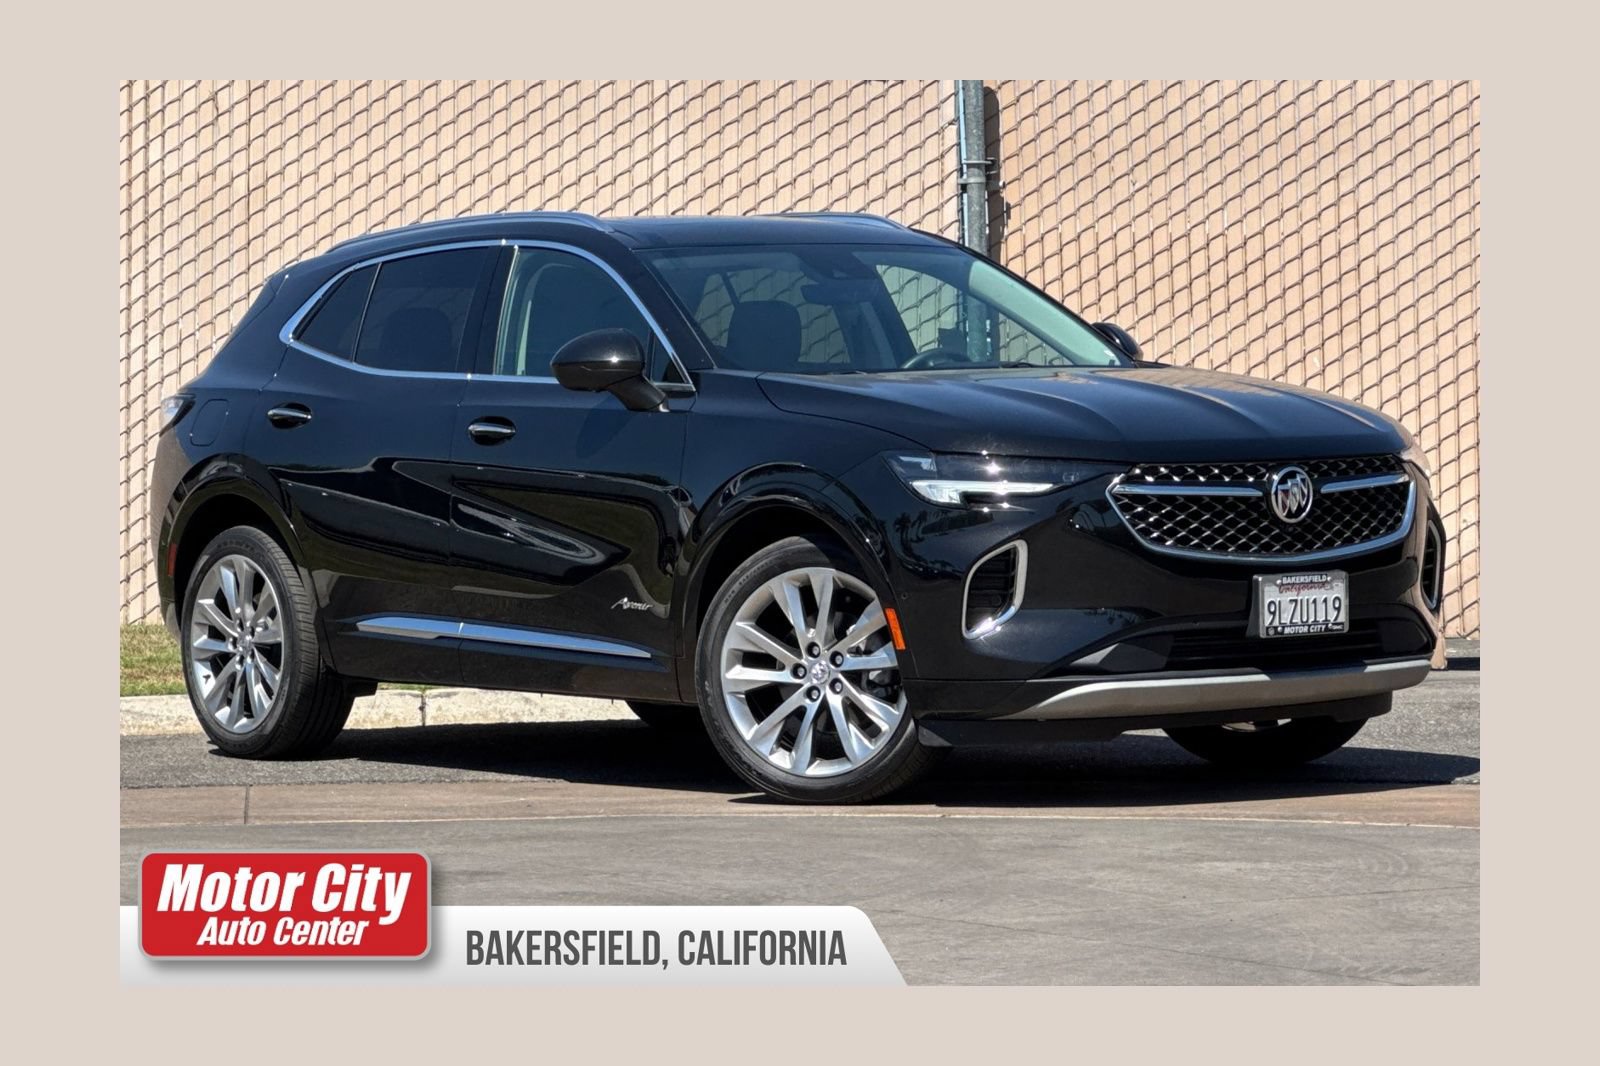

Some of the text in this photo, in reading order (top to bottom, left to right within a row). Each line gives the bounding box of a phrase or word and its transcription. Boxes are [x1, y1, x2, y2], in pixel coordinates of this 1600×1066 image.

[1282, 575, 1327, 584] BAKERSFIELD
[1267, 596, 1341, 626] 9LZU119
[1284, 625, 1308, 634] MOTOR
[1309, 624, 1327, 633] CITY
